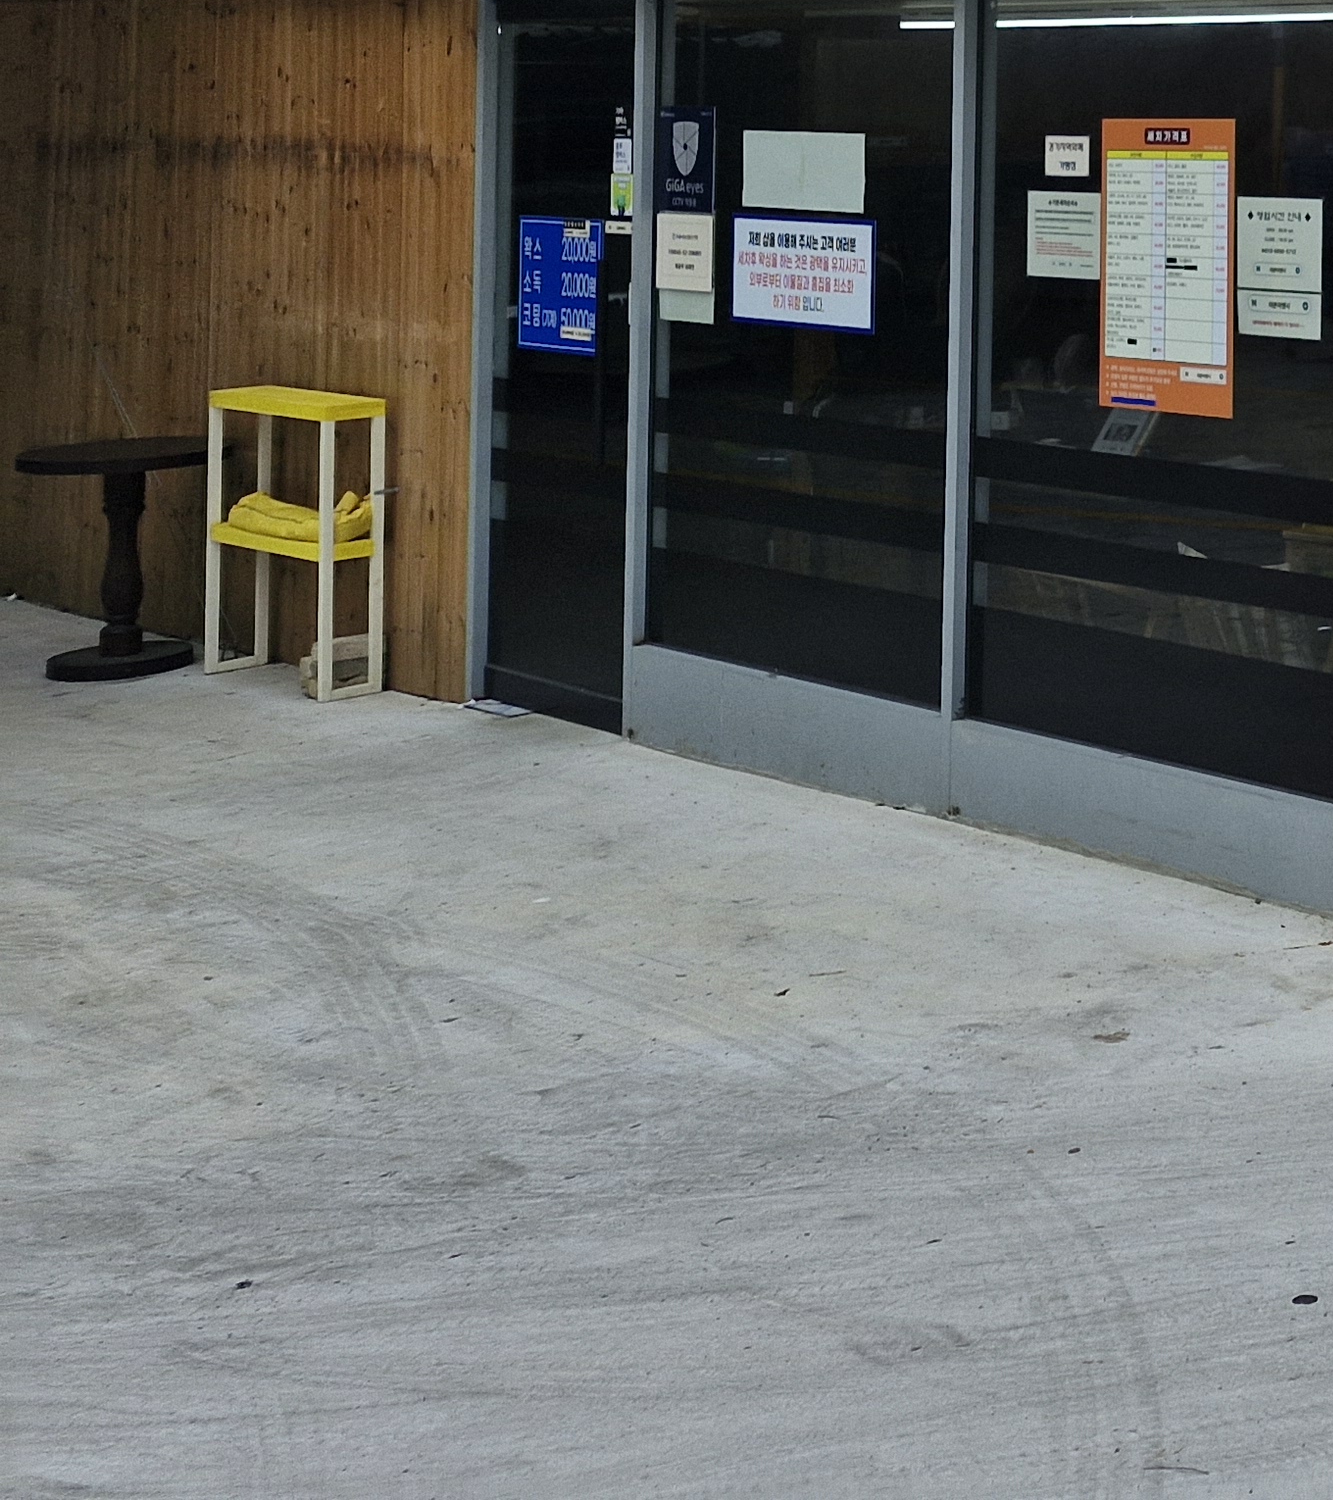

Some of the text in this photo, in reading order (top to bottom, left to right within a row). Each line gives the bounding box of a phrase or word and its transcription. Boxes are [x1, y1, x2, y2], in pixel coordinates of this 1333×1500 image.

[666, 178, 704, 195] GiGA eyes
[524, 236, 542, 260] 왁스
[748, 231, 761, 246] 저희
[777, 234, 797, 249] 이용해
[798, 235, 819, 250] 주시는
[821, 236, 834, 251] 고객
[836, 238, 856, 253] 여러분
[780, 254, 792, 268] 하는
[794, 255, 808, 270] 것은
[810, 256, 829, 271] 광택을
[749, 272, 781, 288] 외부로부터
[833, 278, 854, 294] 최소화
[773, 295, 786, 309] 하기
[788, 296, 800, 311] 위함
